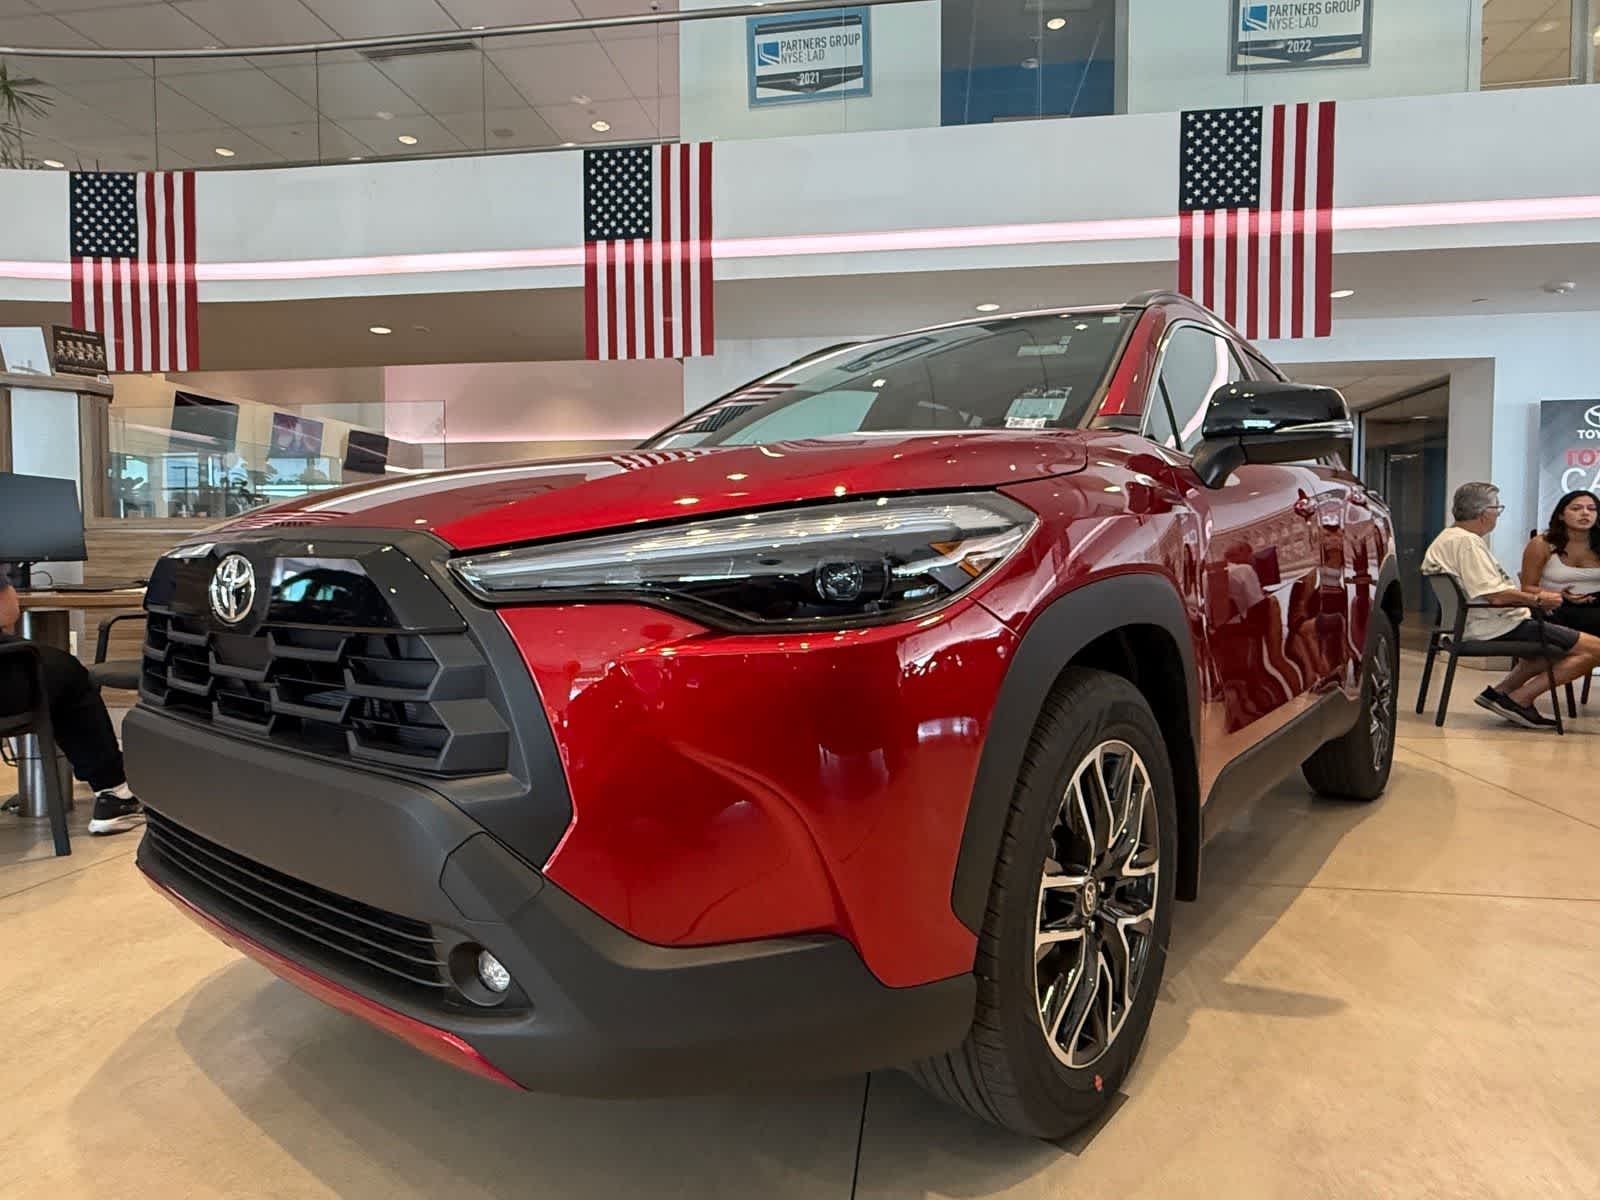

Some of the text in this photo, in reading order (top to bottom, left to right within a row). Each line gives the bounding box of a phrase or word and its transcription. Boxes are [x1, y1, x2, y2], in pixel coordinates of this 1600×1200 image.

[1269, 0, 1361, 17] PARTNERS GROUP
[1268, 16, 1319, 30] NYSE:LAD
[780, 33, 861, 52] PARTNERS GROUP
[1287, 40, 1312, 53] 2022
[781, 49, 825, 64] NYSE:LAD
[799, 72, 820, 85] 2021
[1565, 448, 1600, 466] TO
